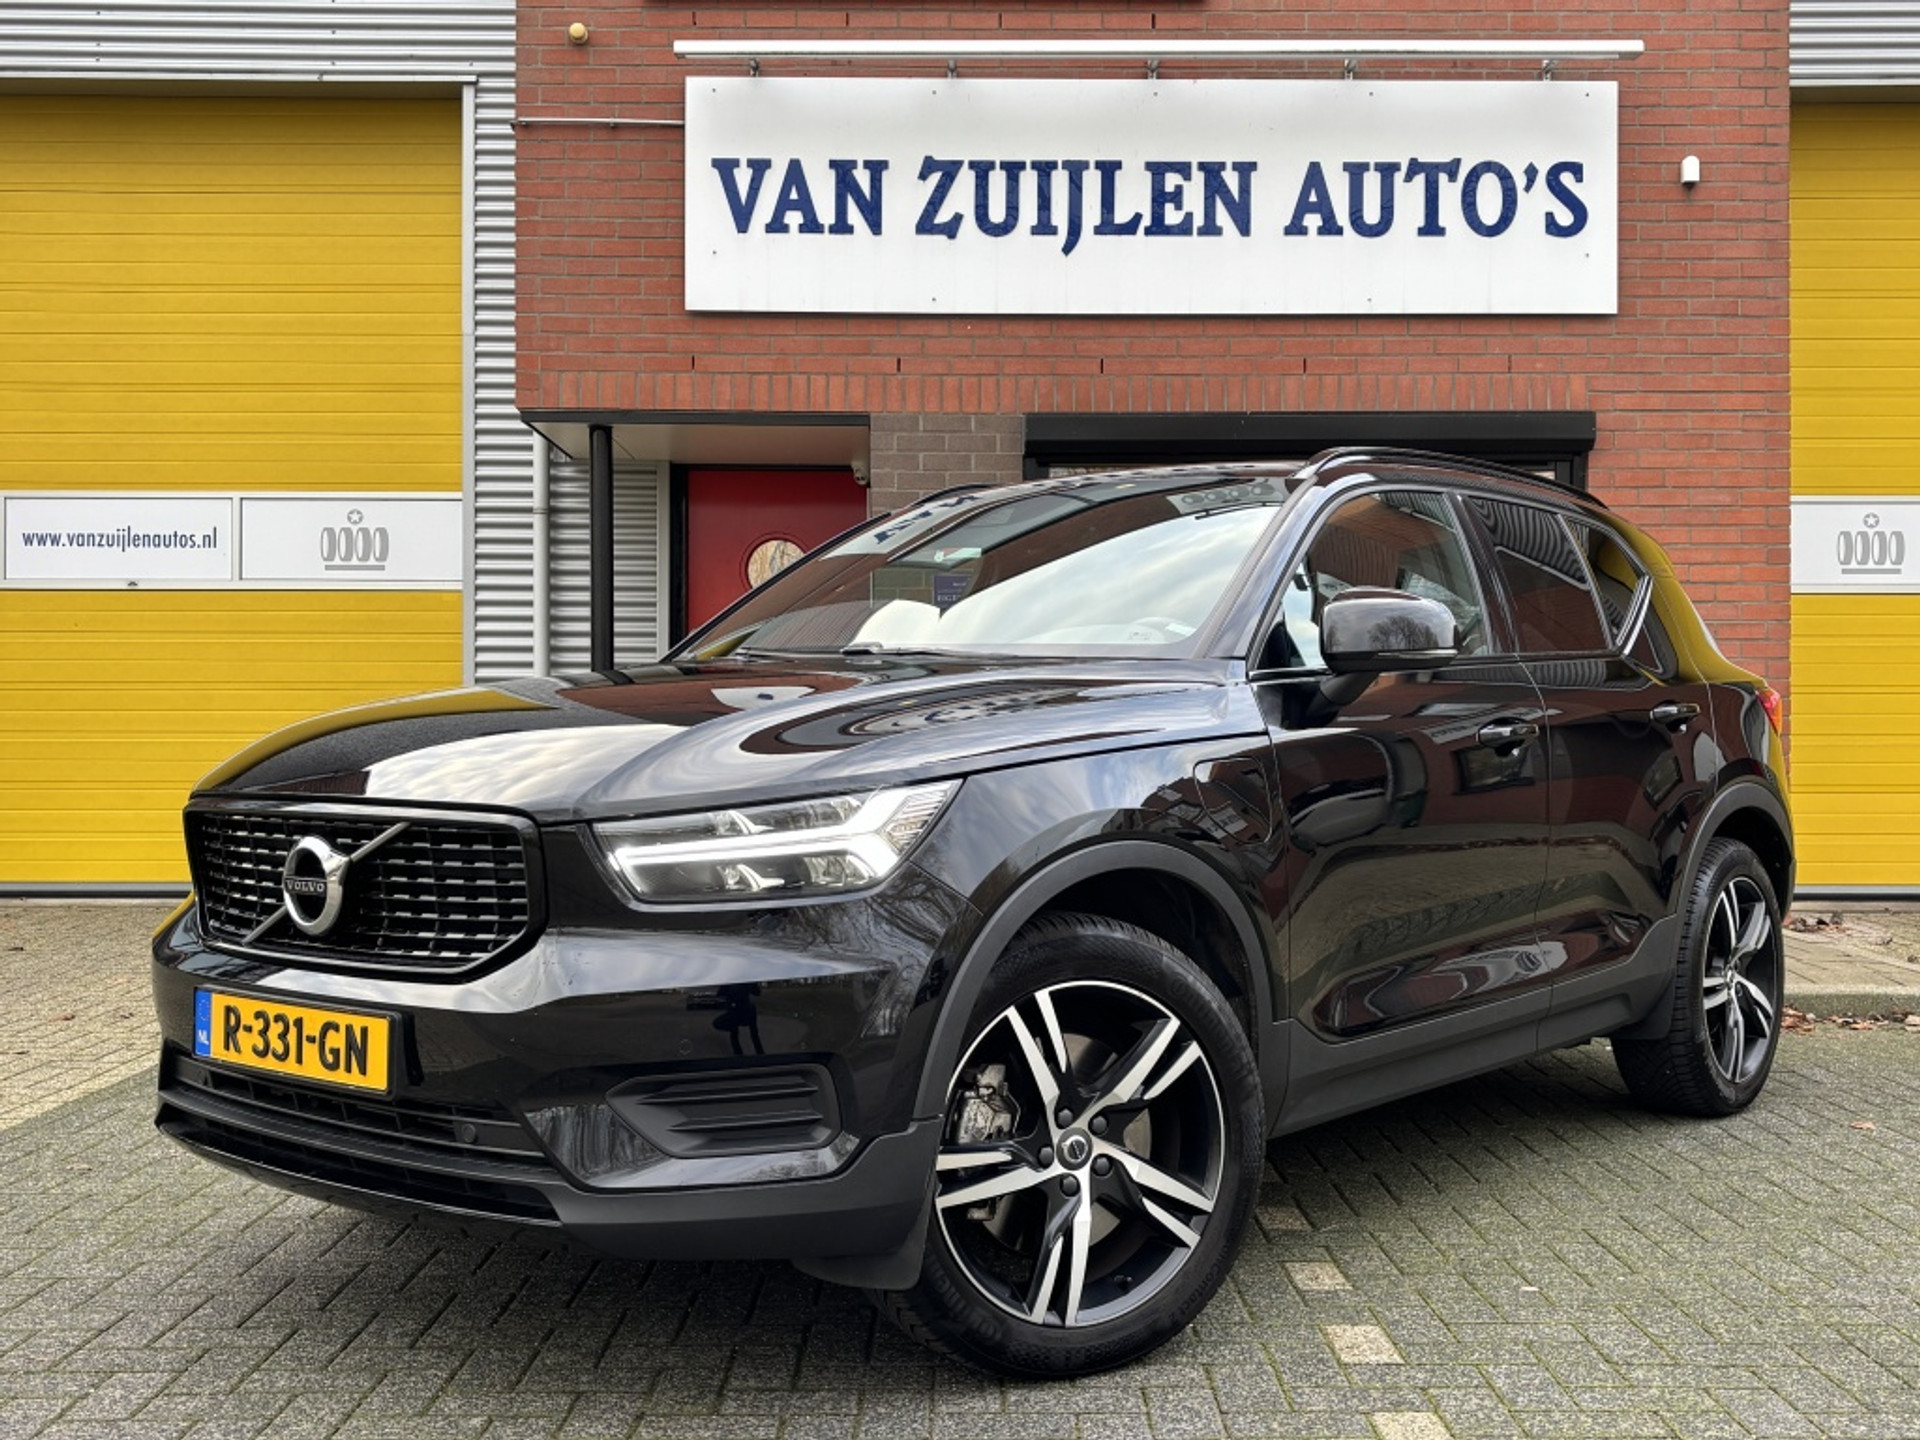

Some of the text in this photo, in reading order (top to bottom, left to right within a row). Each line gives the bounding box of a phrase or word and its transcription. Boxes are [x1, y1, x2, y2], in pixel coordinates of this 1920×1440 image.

[712, 155, 1588, 257] VAN ZUIJLEN AUTO'S
[22, 525, 217, 553] www.vanzuijlenautos.nl
[285, 879, 325, 893] VOLVO
[198, 1029, 209, 1046] NL
[223, 1004, 369, 1077] R-331-GN
